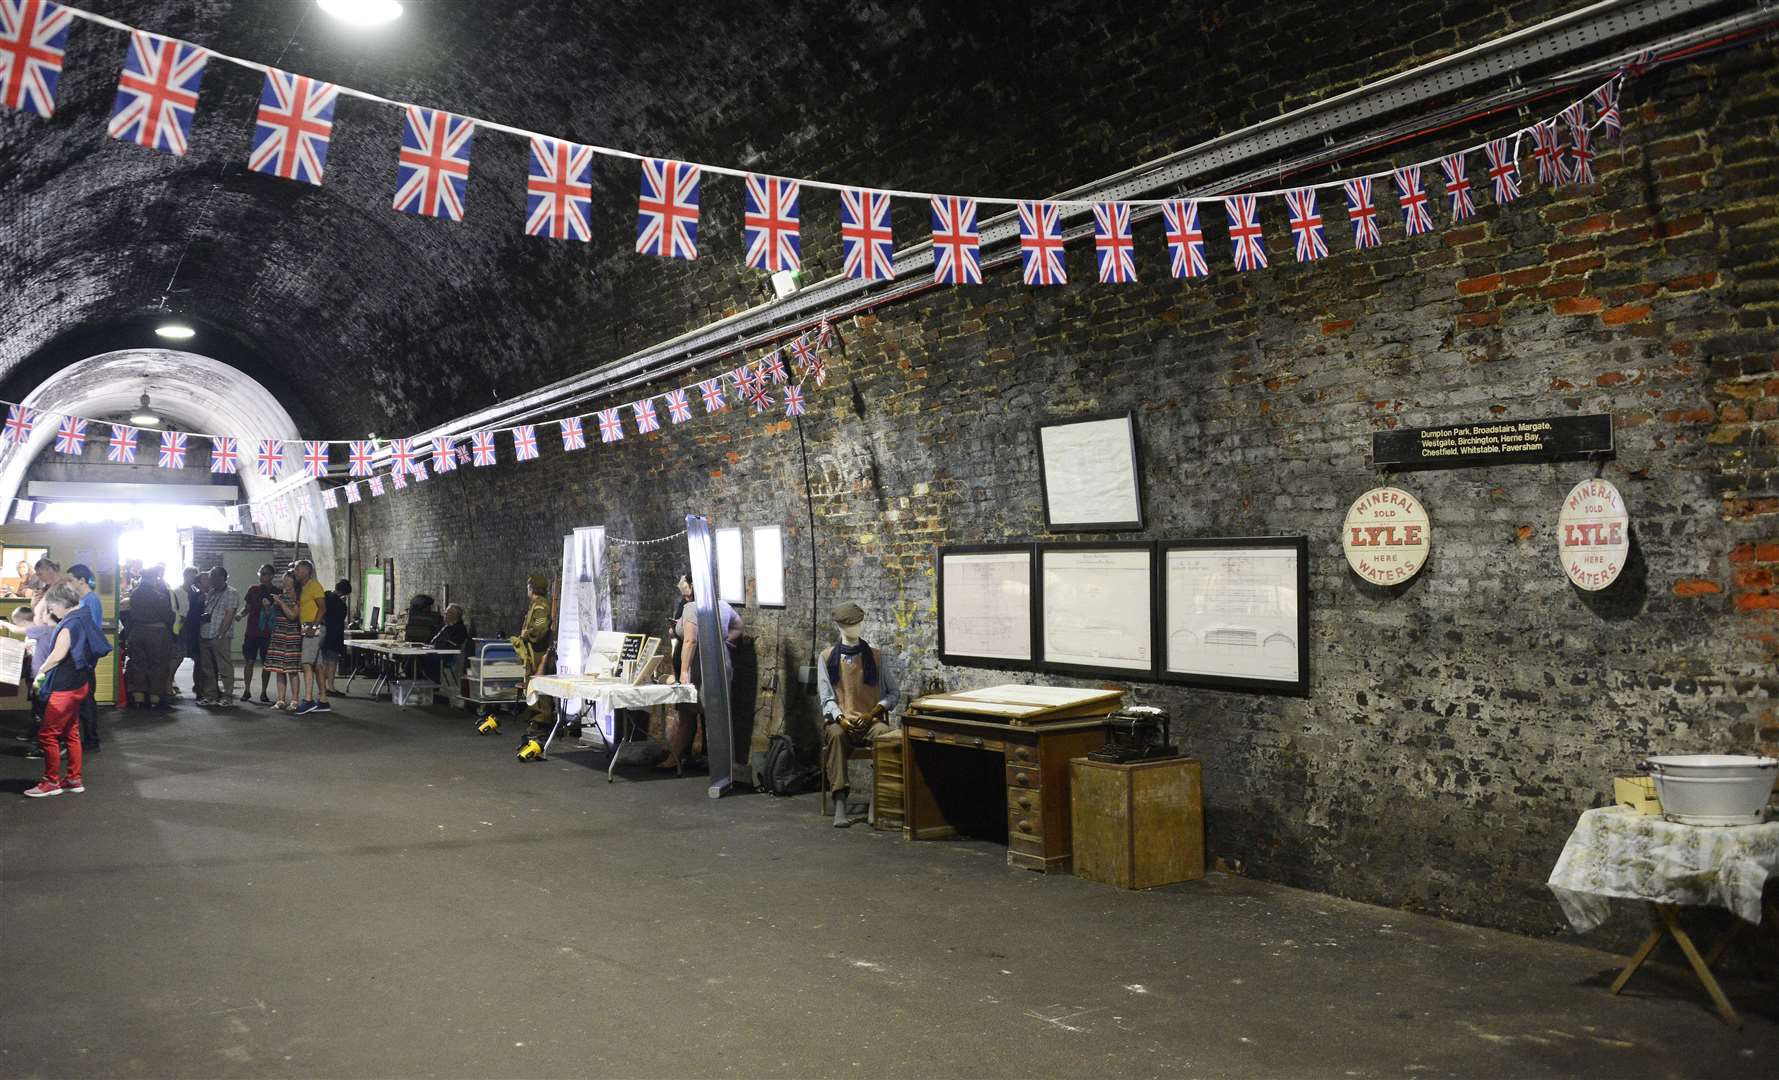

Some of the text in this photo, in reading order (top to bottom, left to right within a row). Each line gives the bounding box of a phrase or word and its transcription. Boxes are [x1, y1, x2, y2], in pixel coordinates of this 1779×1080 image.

[1421, 430, 1452, 438] Dumpton
[1501, 434, 1522, 442] Herne
[1502, 443, 1542, 452] Faversham
[1356, 492, 1413, 515] MINERAL
[1569, 485, 1617, 510] MINERAL
[1585, 505, 1603, 513] SOLD
[1351, 526, 1422, 546] LYLE
[1565, 522, 1622, 546] LYLE
[1359, 560, 1415, 580] WATERS
[1571, 562, 1617, 585] WATERS
